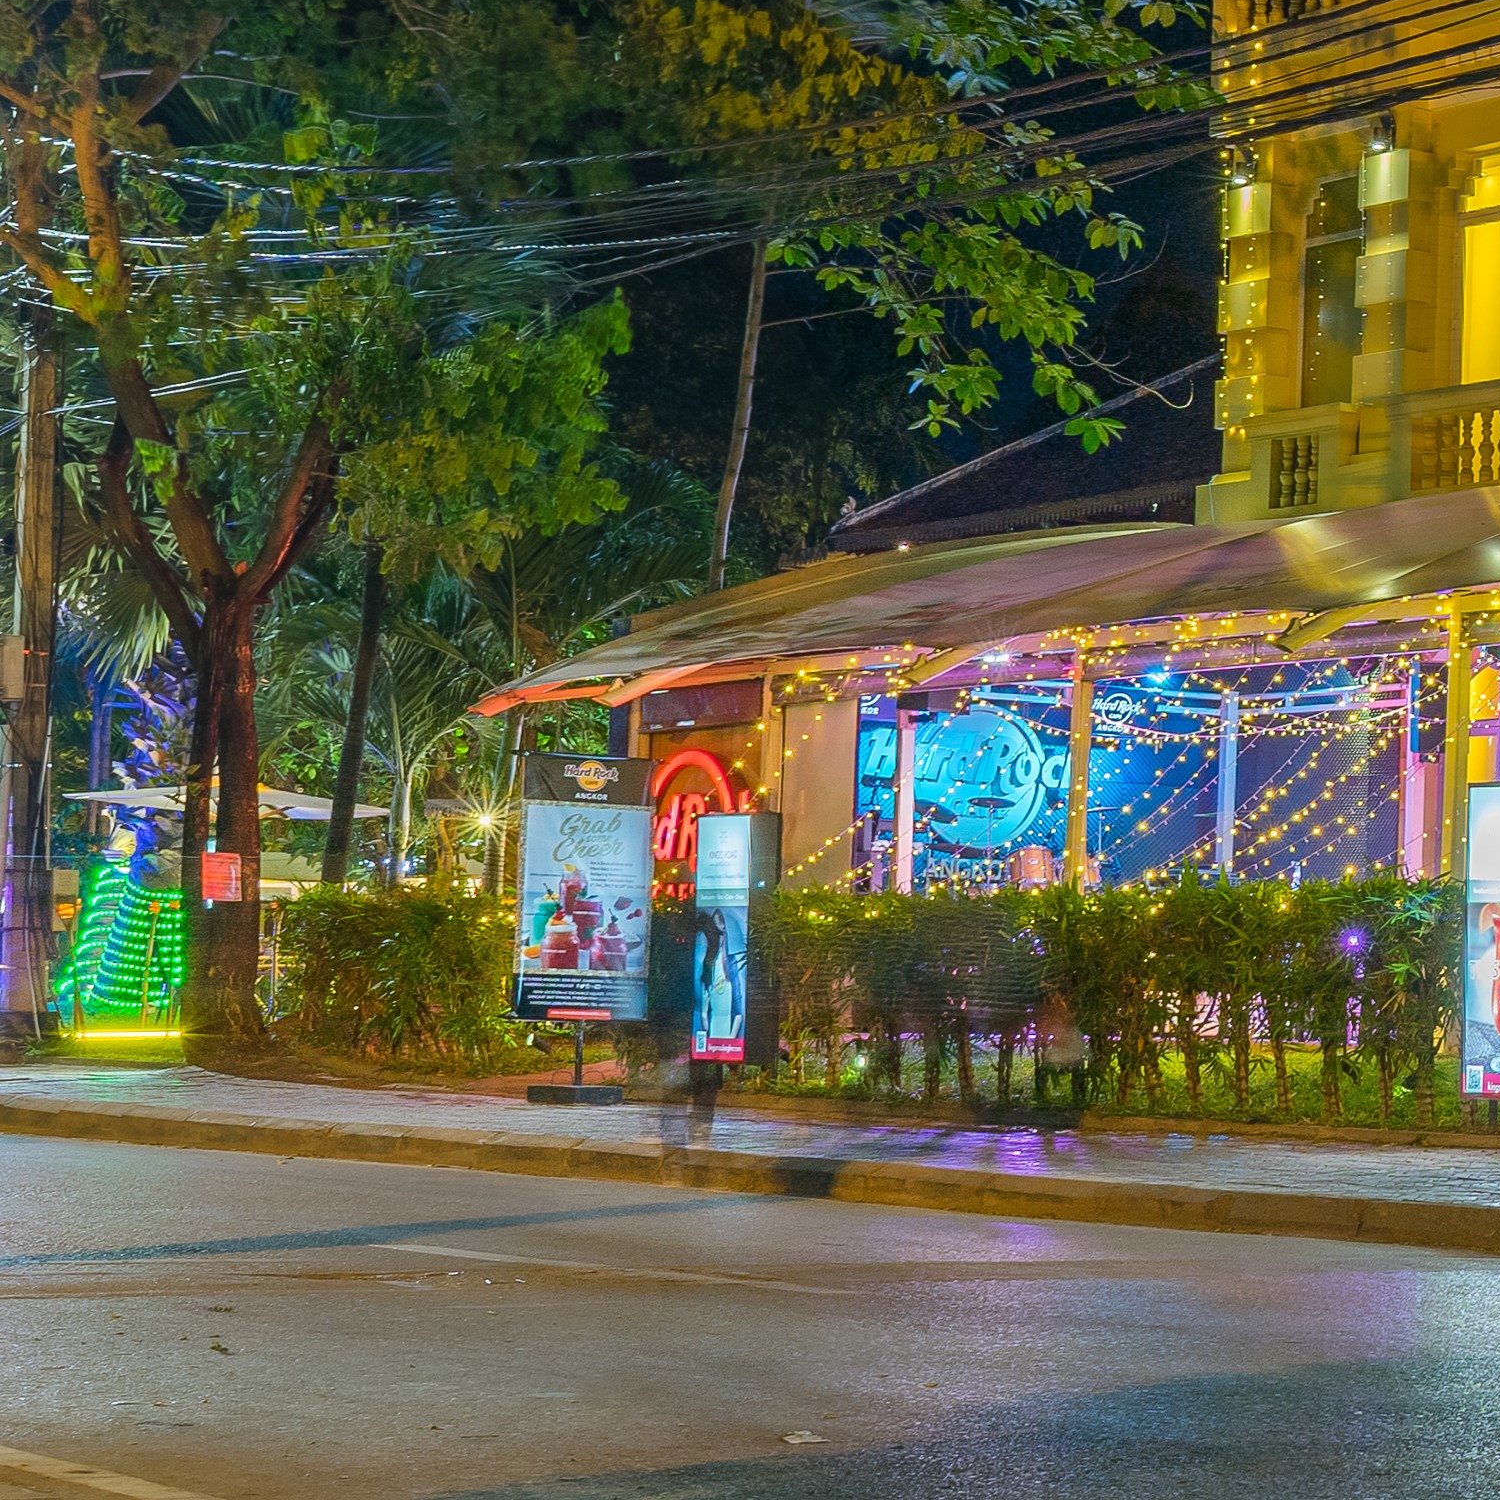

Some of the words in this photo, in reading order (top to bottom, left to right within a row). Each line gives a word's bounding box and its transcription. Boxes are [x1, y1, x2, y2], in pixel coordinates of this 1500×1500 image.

[1091, 698, 1117, 711] Hard
[1117, 700, 1142, 714] Rock
[564, 764, 592, 778] Hard
[592, 766, 620, 782] Rock
[575, 792, 609, 801] ANGKOR
[560, 811, 622, 838] Grab
[552, 837, 624, 863] Cheer
[923, 857, 1002, 881] ANGKO
